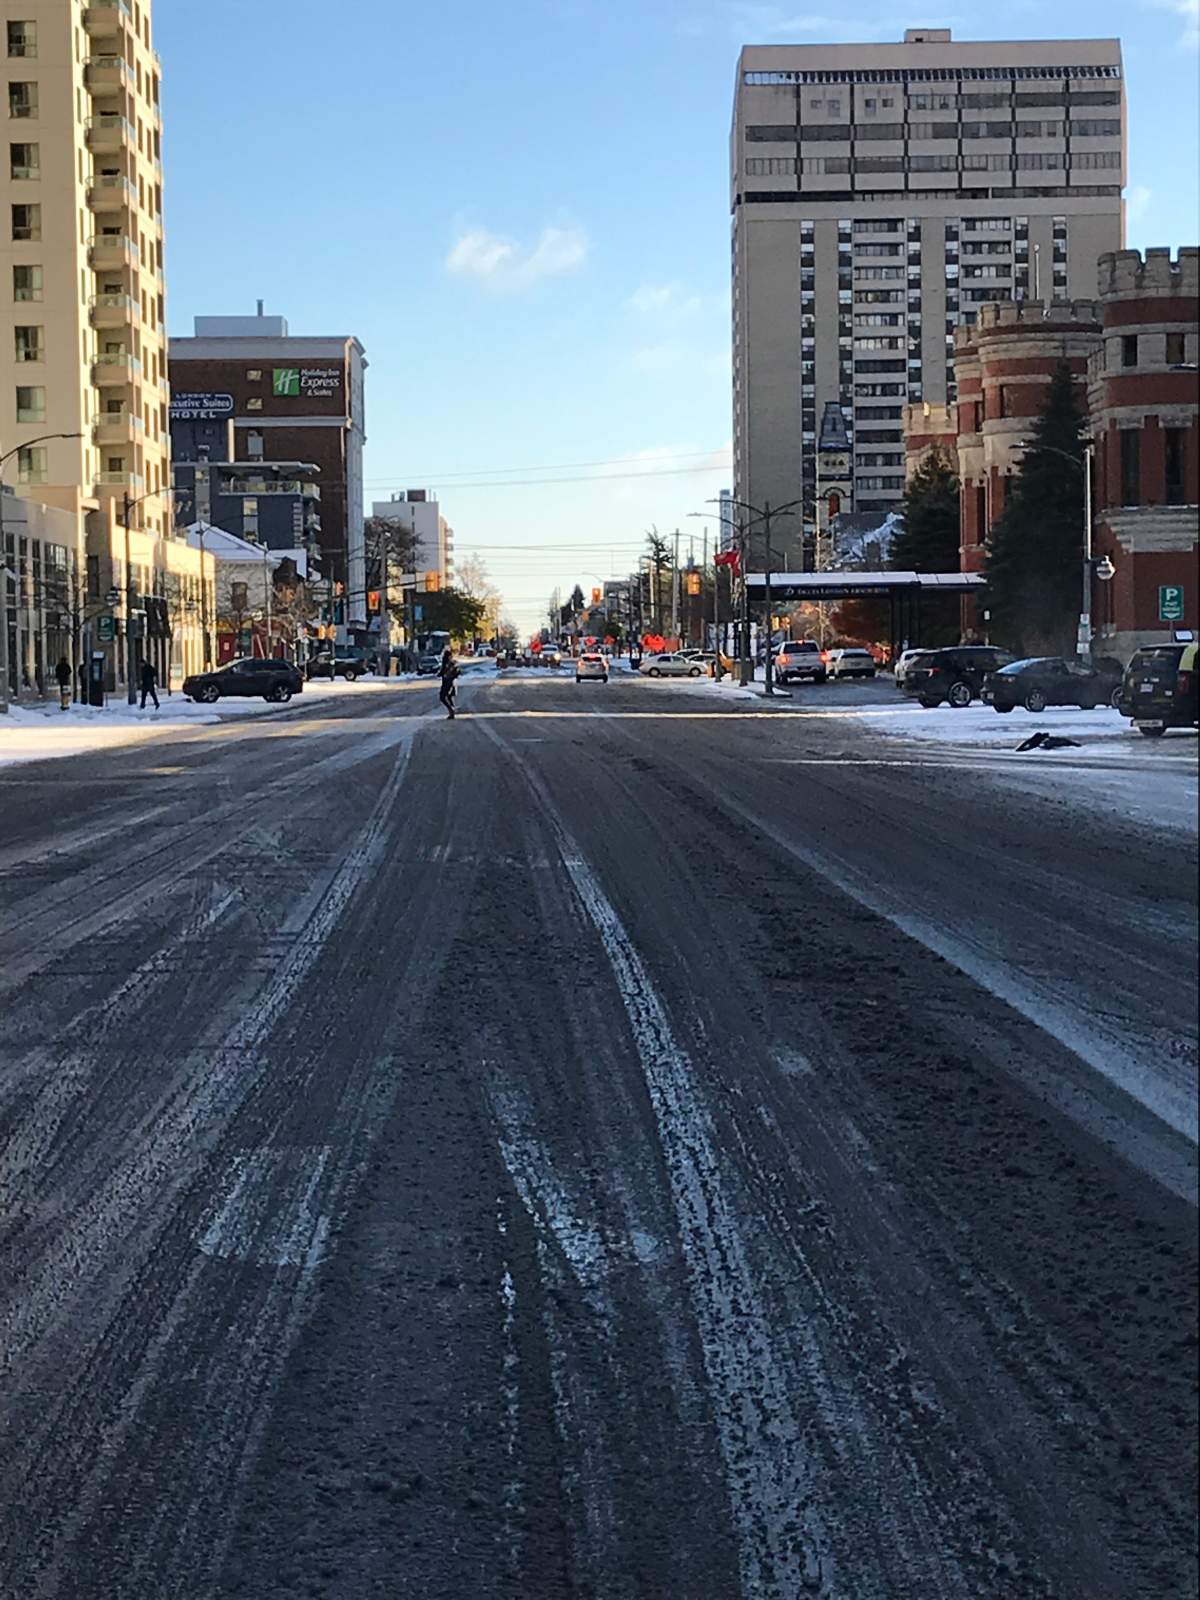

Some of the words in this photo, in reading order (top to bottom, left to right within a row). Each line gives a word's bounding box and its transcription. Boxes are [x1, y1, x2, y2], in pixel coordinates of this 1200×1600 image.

[301, 377, 340, 388] Express
[202, 398, 230, 408] Suites
[1166, 588, 1178, 600] P
[101, 618, 111, 627] P
